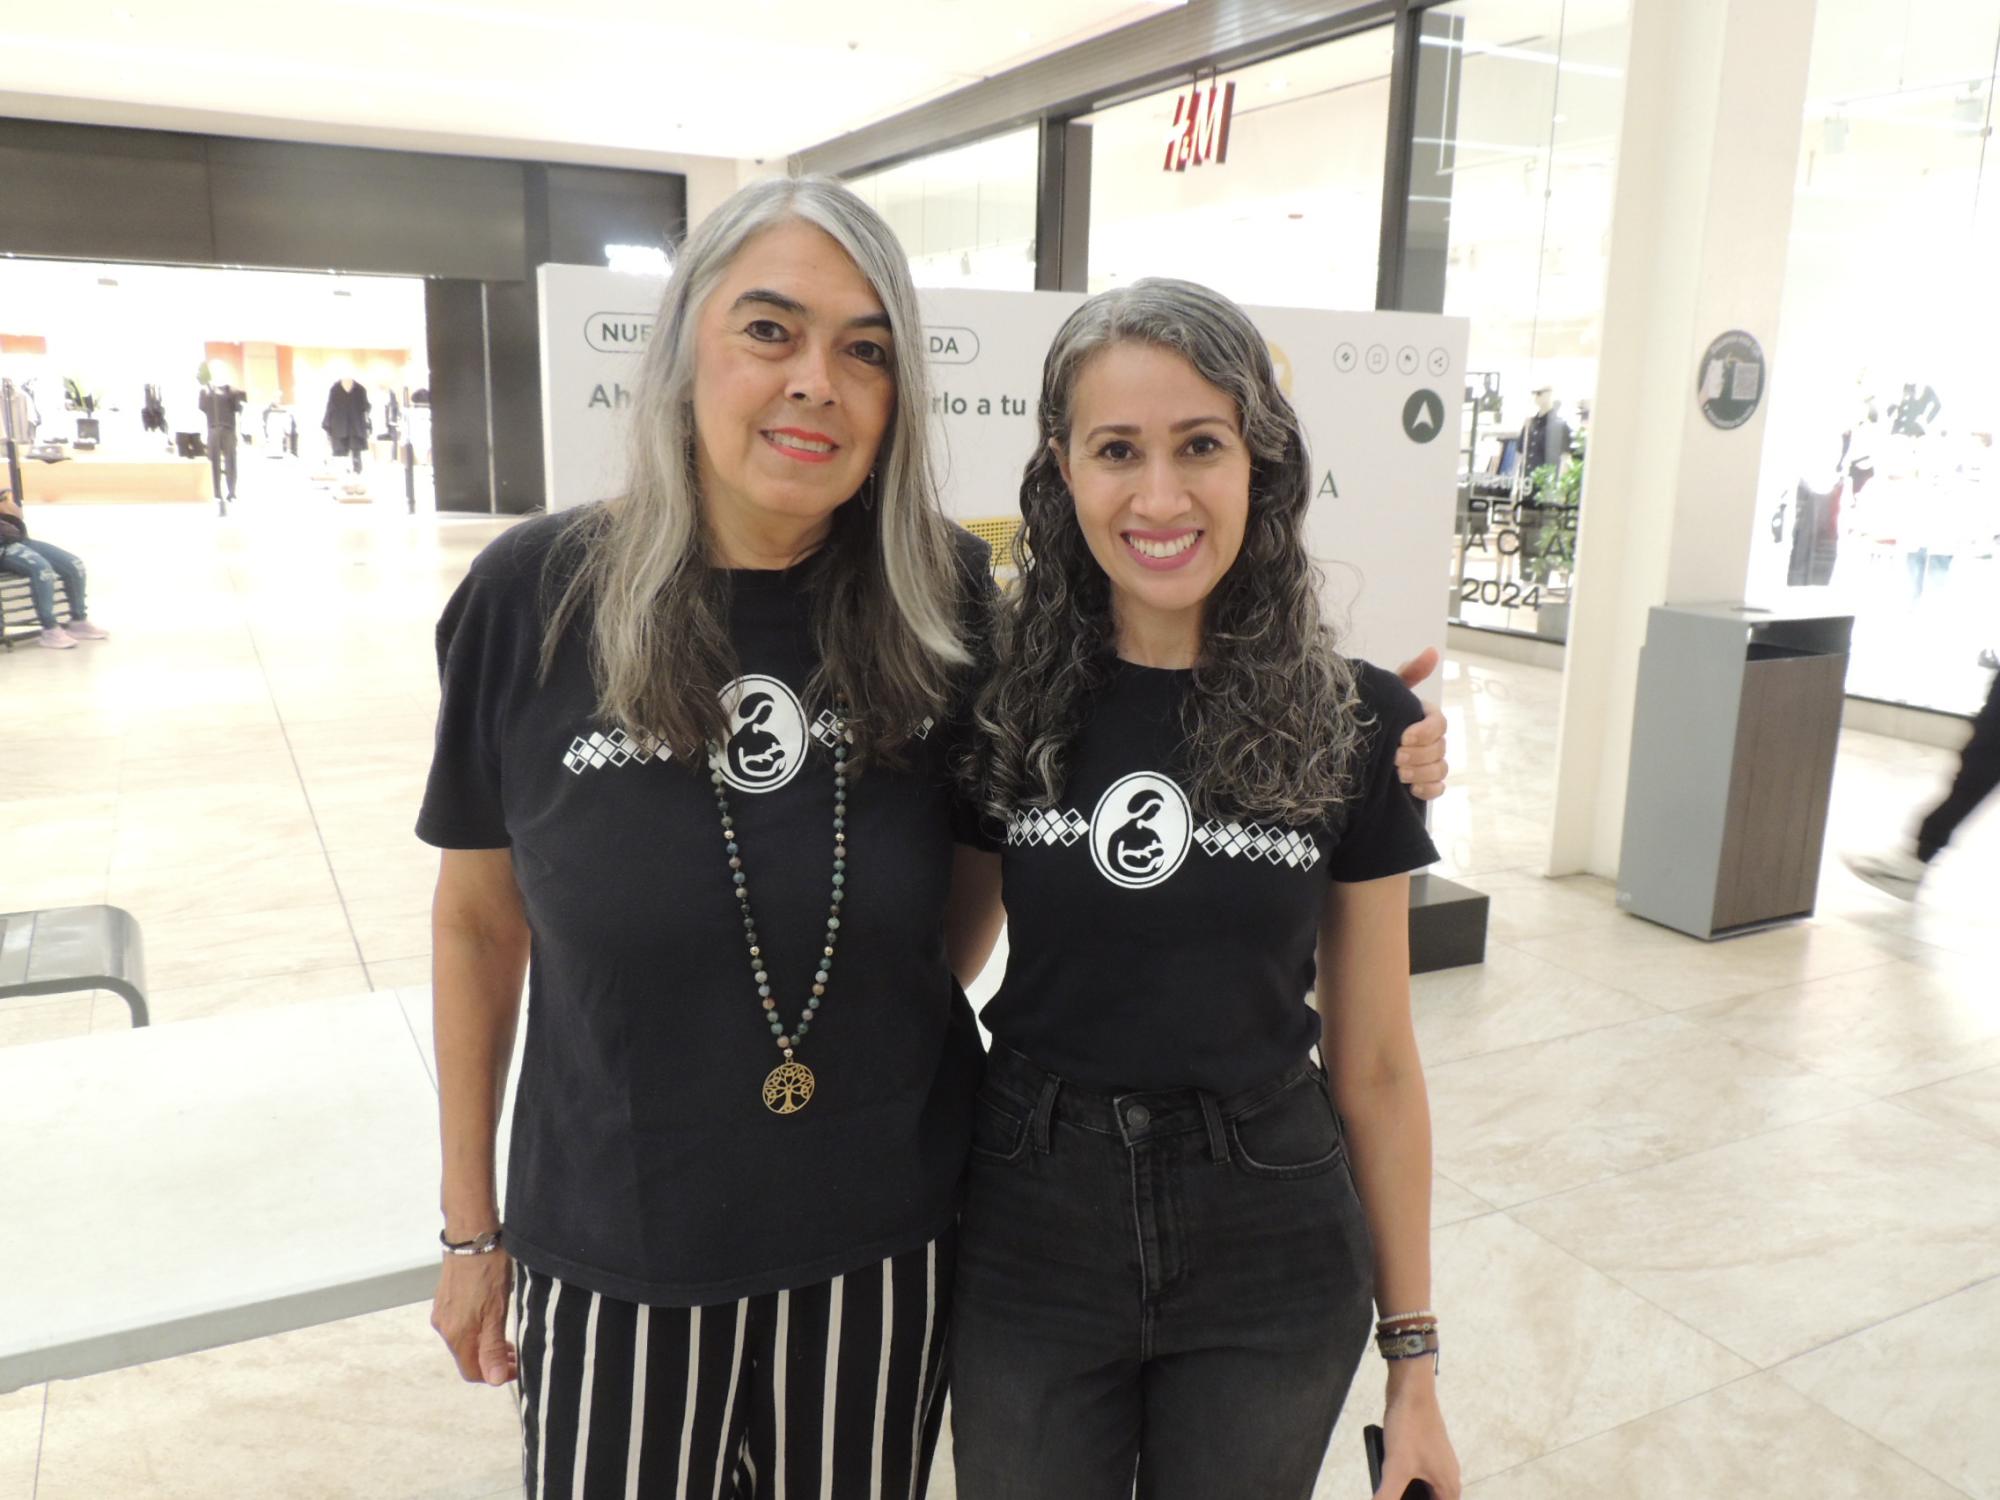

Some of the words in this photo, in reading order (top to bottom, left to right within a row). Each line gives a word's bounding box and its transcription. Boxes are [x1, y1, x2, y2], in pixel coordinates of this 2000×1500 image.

[1162, 81, 1236, 172] H&M
[601, 322, 656, 342] NUE
[929, 335, 960, 354] DA
[587, 383, 633, 409] Ah
[931, 391, 968, 415] rlo
[976, 397, 991, 415] a
[1000, 394, 1026, 416] tu
[1467, 498, 1580, 531] REGRE
[1464, 529, 1488, 553] A
[1460, 577, 1541, 612] 2024
